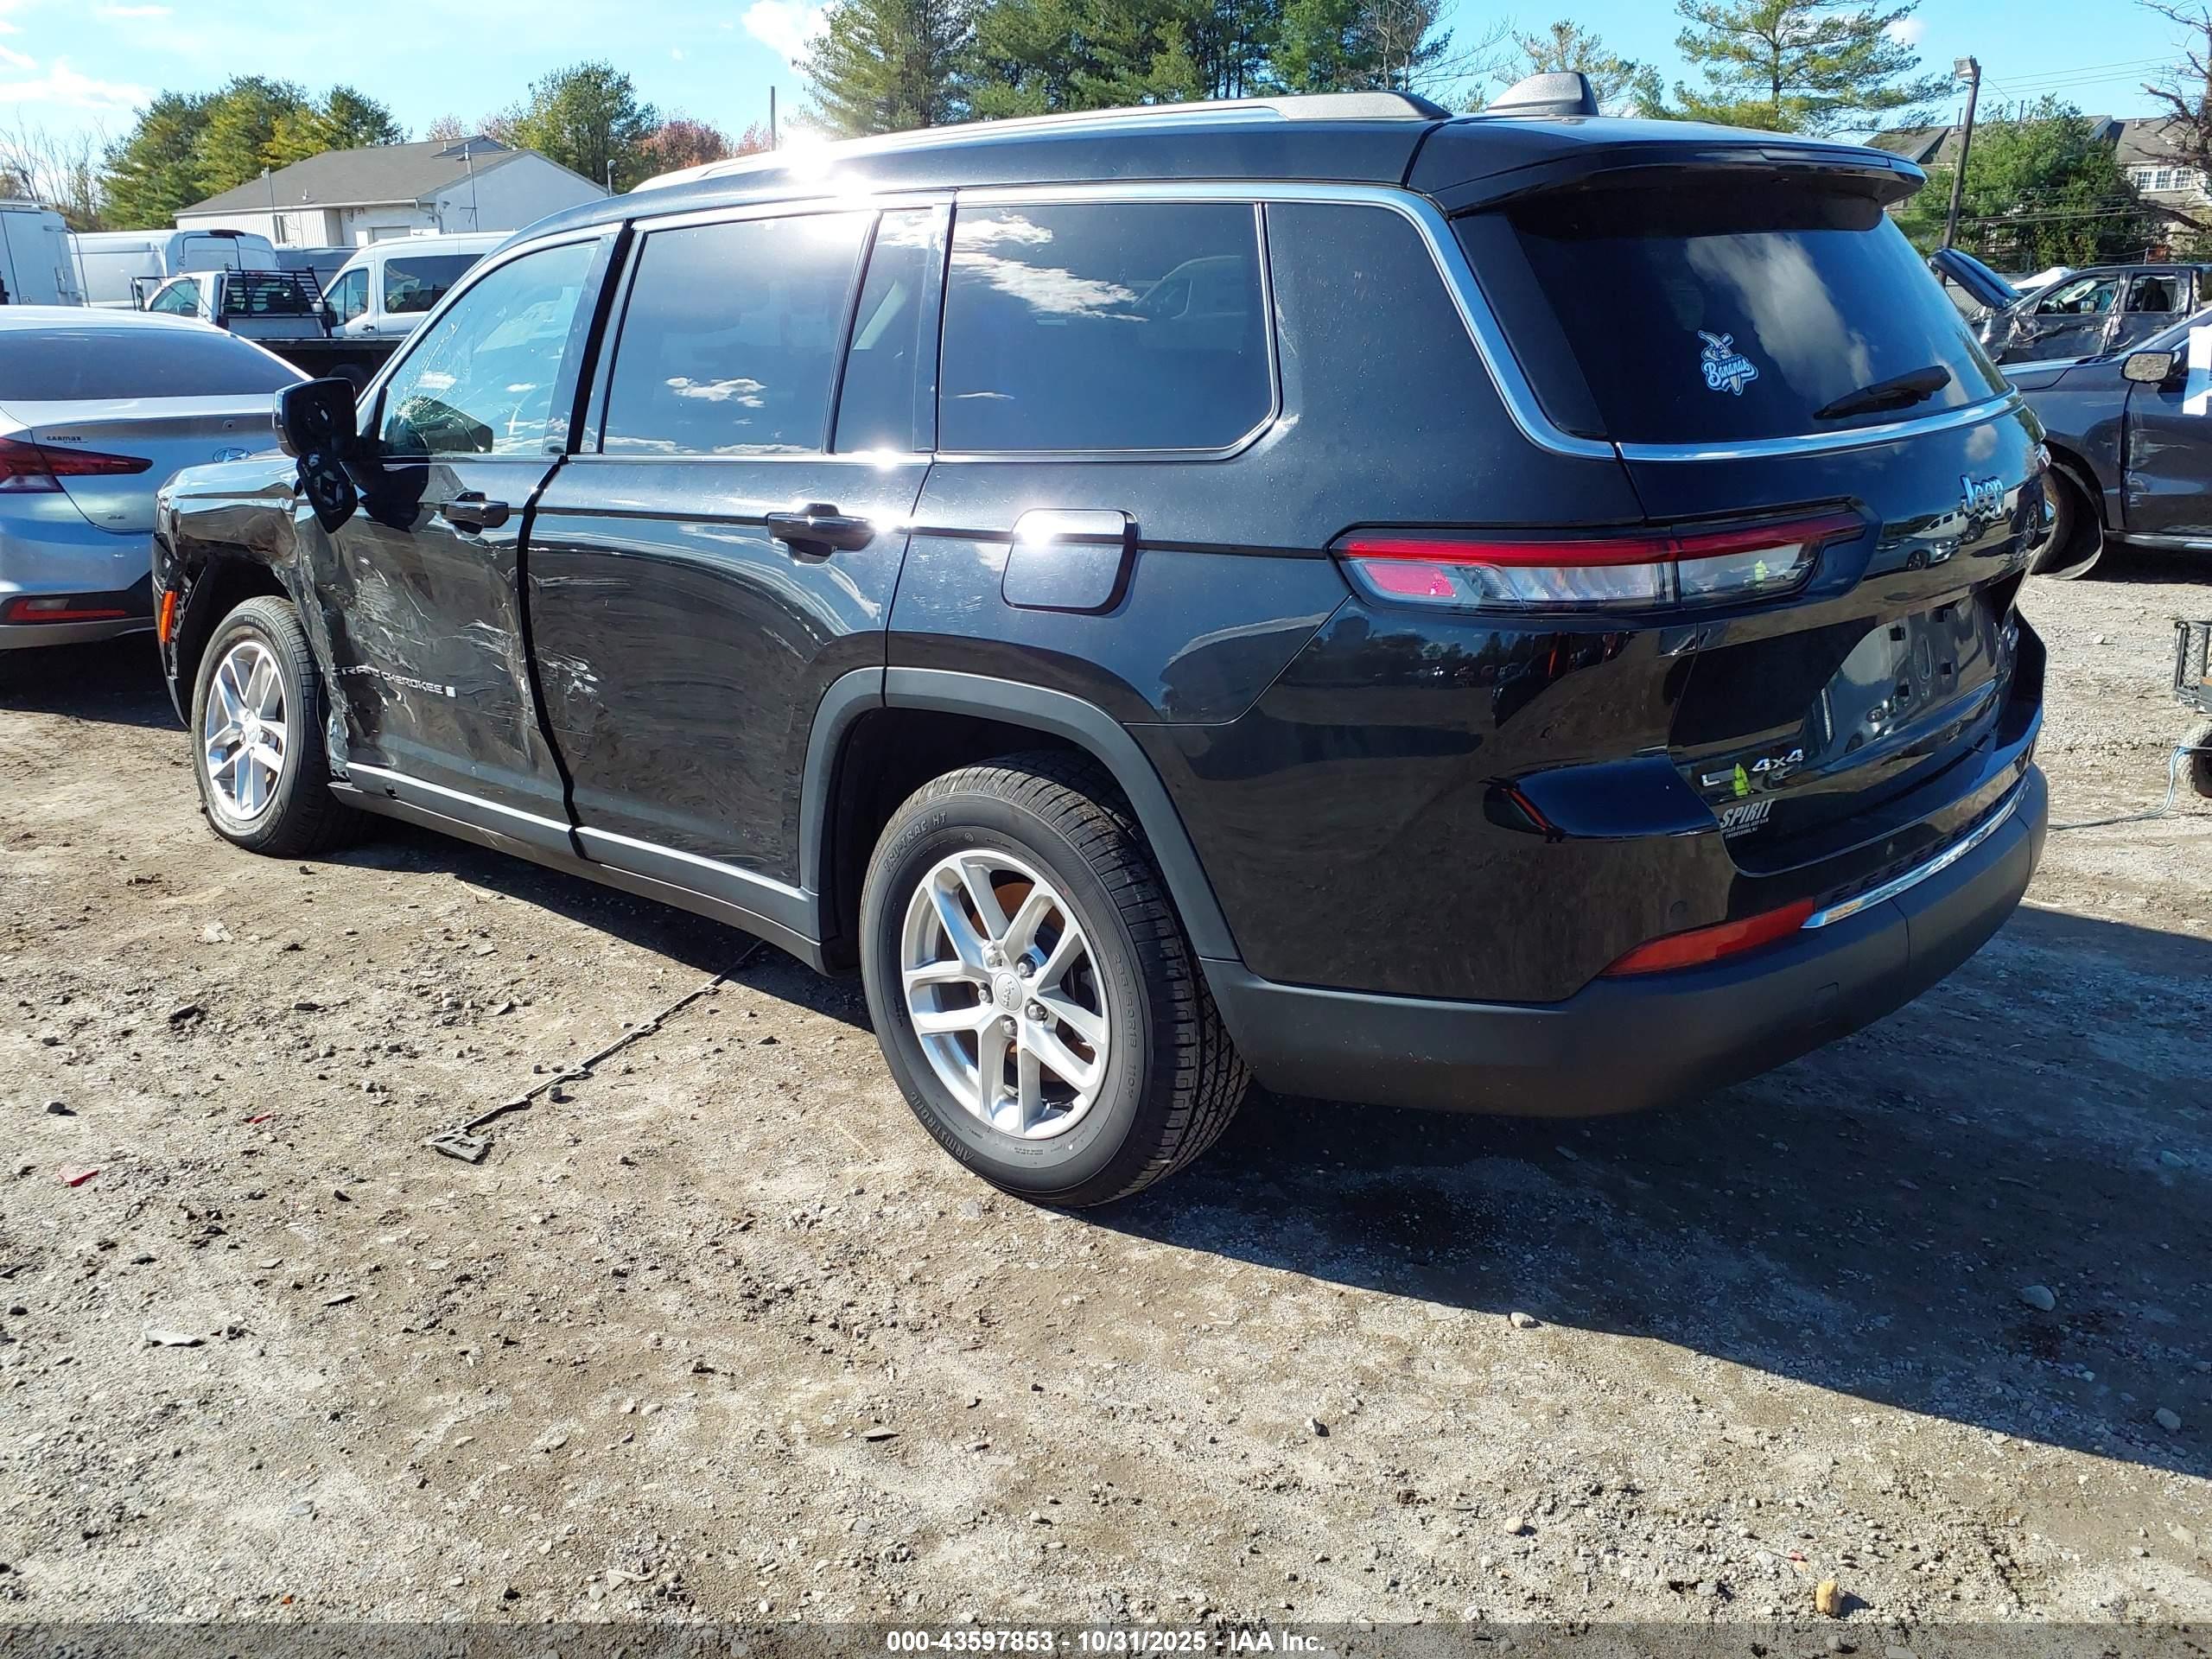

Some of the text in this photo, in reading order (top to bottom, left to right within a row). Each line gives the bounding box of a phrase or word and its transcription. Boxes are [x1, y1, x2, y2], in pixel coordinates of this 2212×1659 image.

[1704, 359, 1751, 387] Bananas
[1960, 474, 2005, 517] Jeep
[380, 671, 444, 695] CHEROKEE
[1750, 748, 1804, 772] 4x4
[932, 811, 947, 827] HT
[1719, 798, 1777, 829] SPIRIT
[910, 1091, 975, 1162] ARMSTRONG
